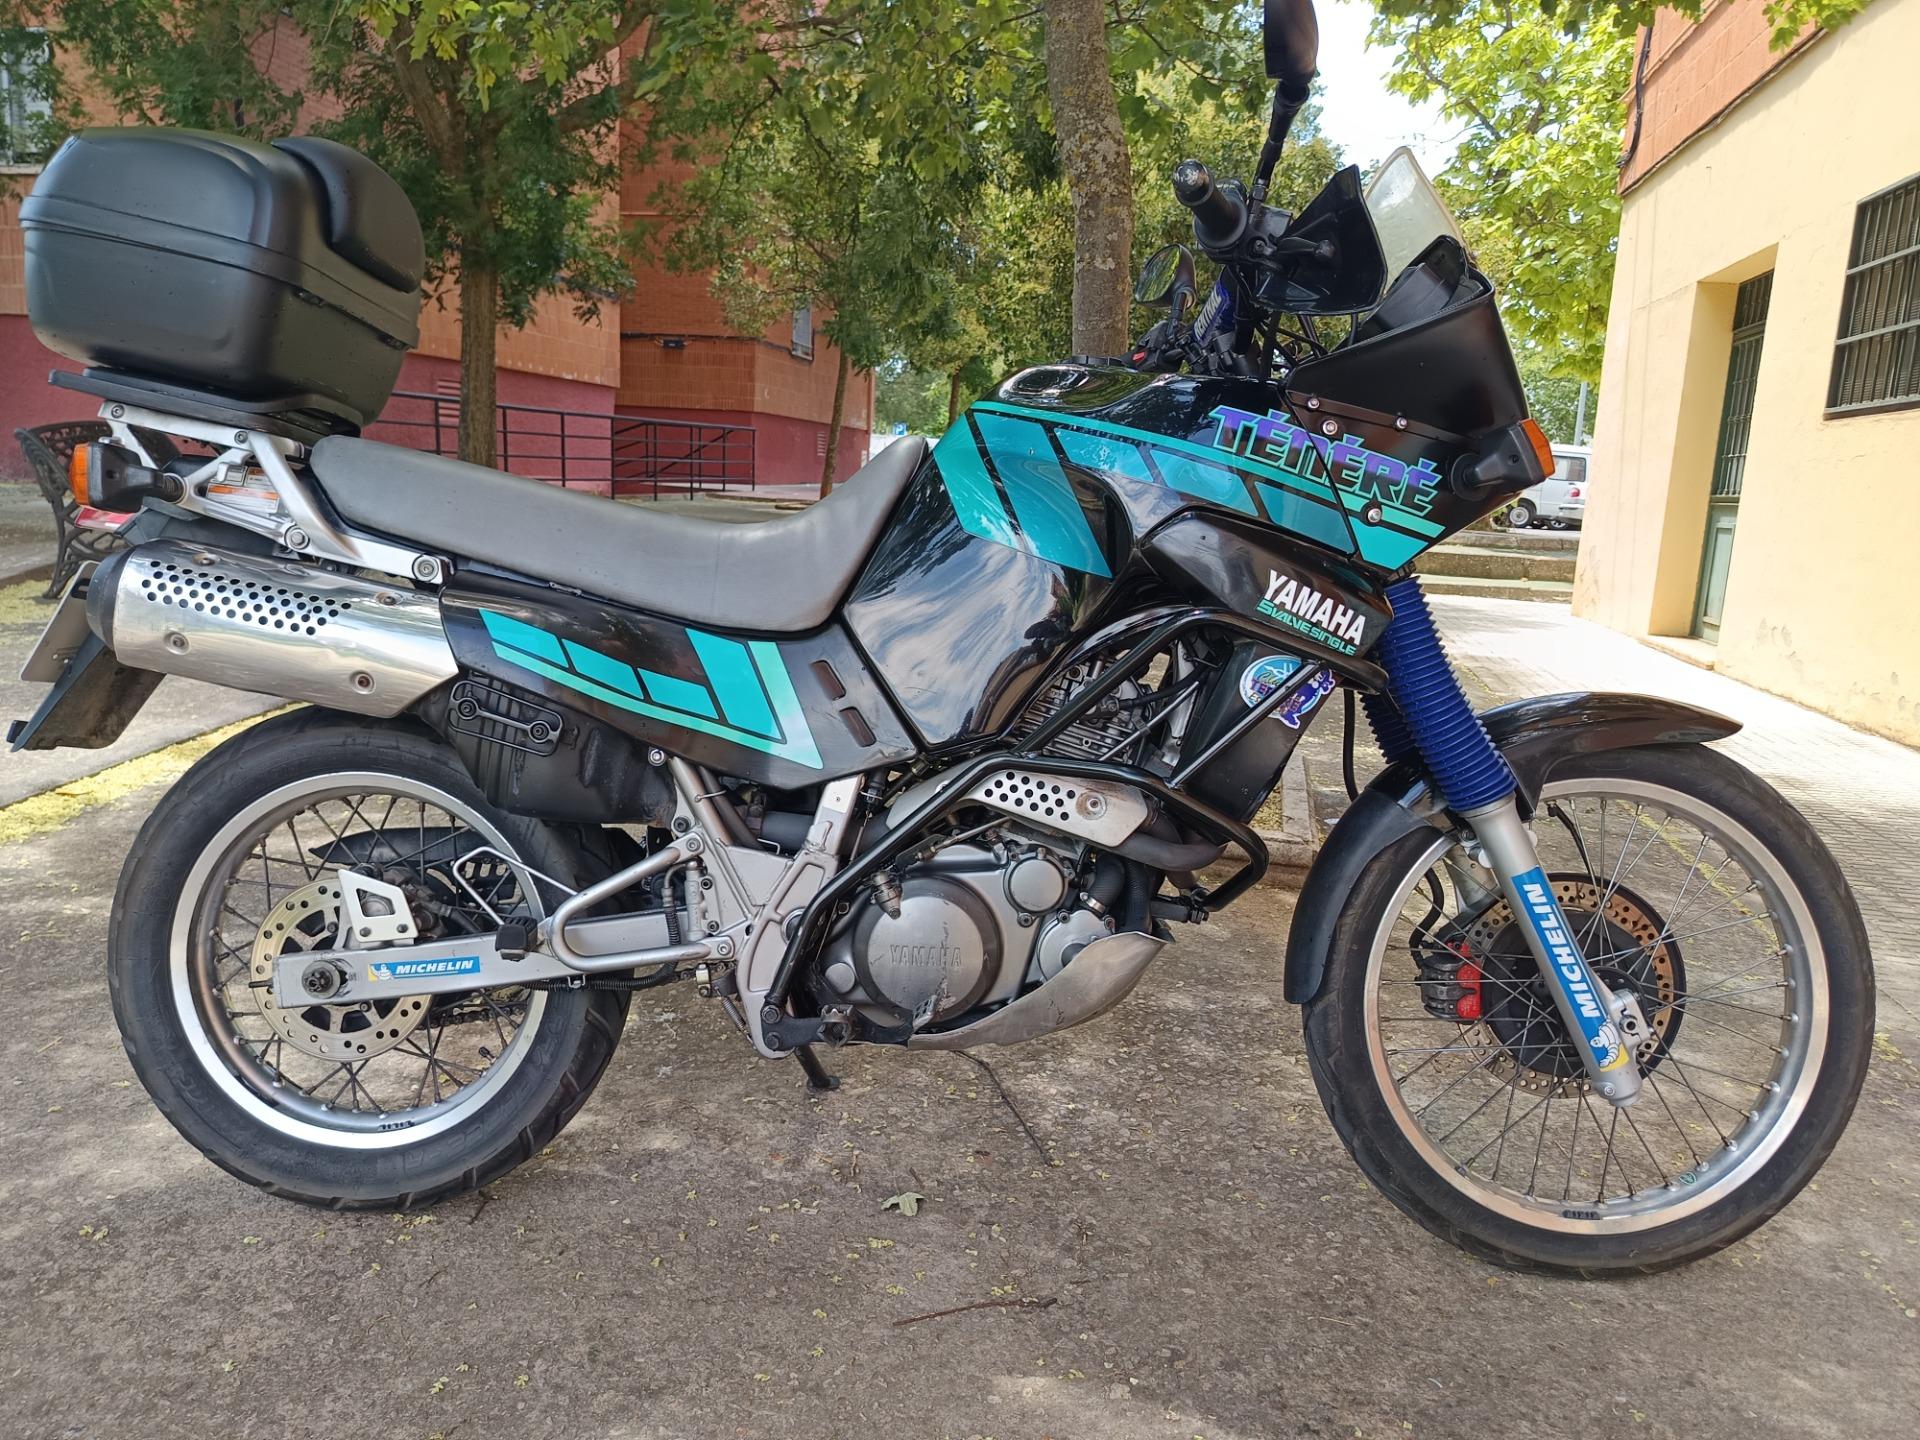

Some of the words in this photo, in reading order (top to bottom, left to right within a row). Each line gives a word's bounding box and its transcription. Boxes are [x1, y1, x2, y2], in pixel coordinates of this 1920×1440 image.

[1264, 569, 1366, 646] YAMAHA
[396, 960, 474, 974] MICHELIN
[890, 944, 962, 967] YAMAHA
[1522, 883, 1601, 1019] MICHELIN
